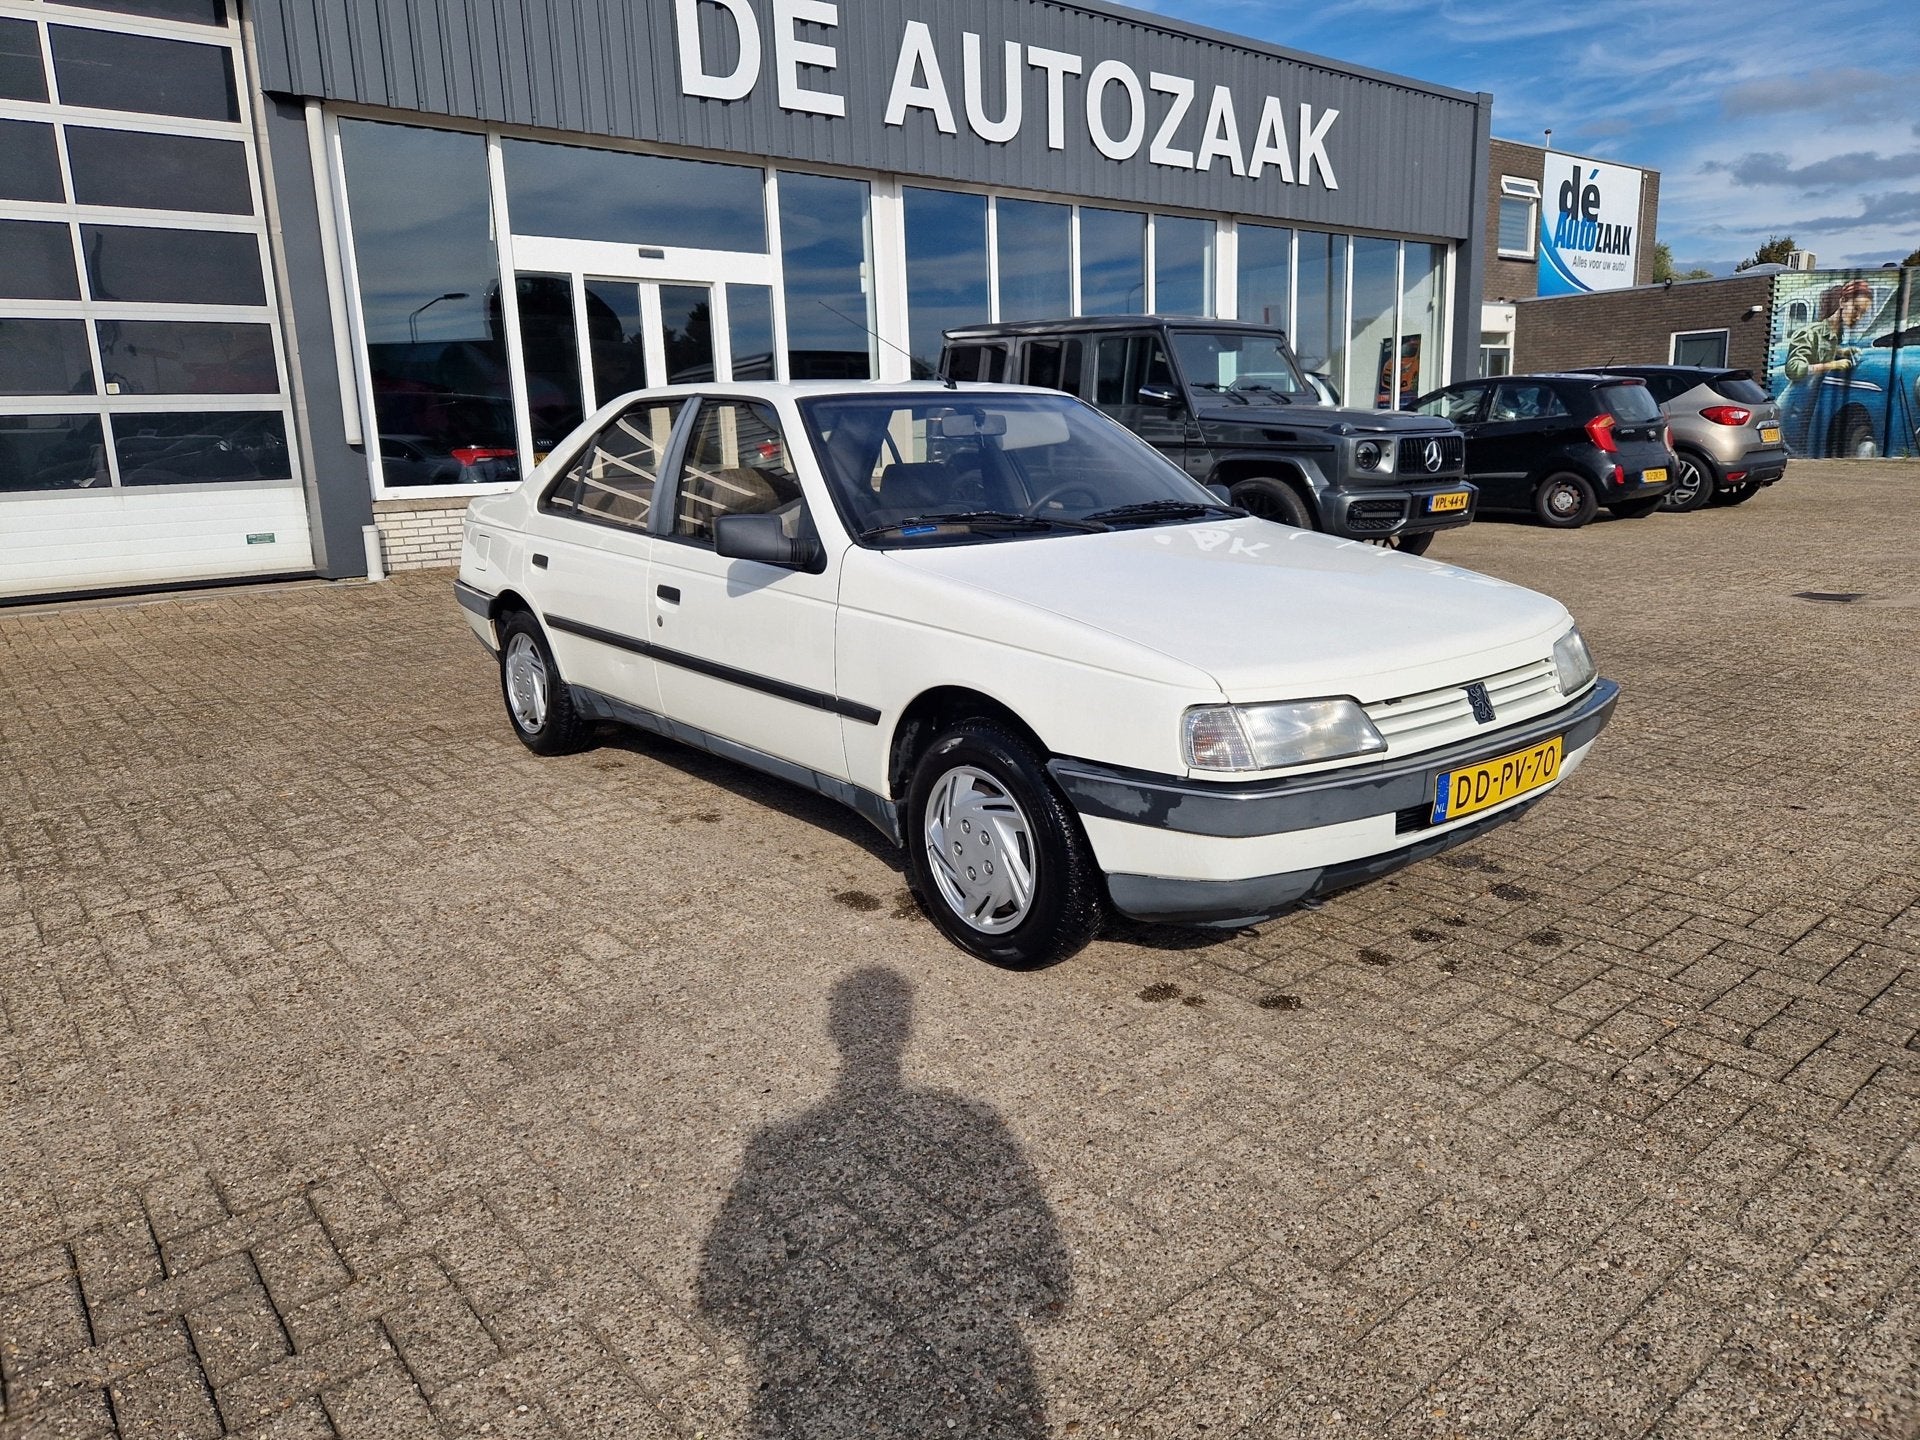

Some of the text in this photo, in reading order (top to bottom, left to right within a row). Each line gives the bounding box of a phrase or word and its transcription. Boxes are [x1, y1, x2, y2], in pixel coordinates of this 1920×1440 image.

[675, 0, 1340, 190] DE AUTOZAAK
[1559, 165, 1600, 222] dé
[1572, 255, 1588, 269] Alles
[1588, 259, 1602, 270] voor
[1602, 262, 1611, 270] uw
[1455, 745, 1555, 810] DD-PV-70
[1434, 802, 1446, 814] NL
